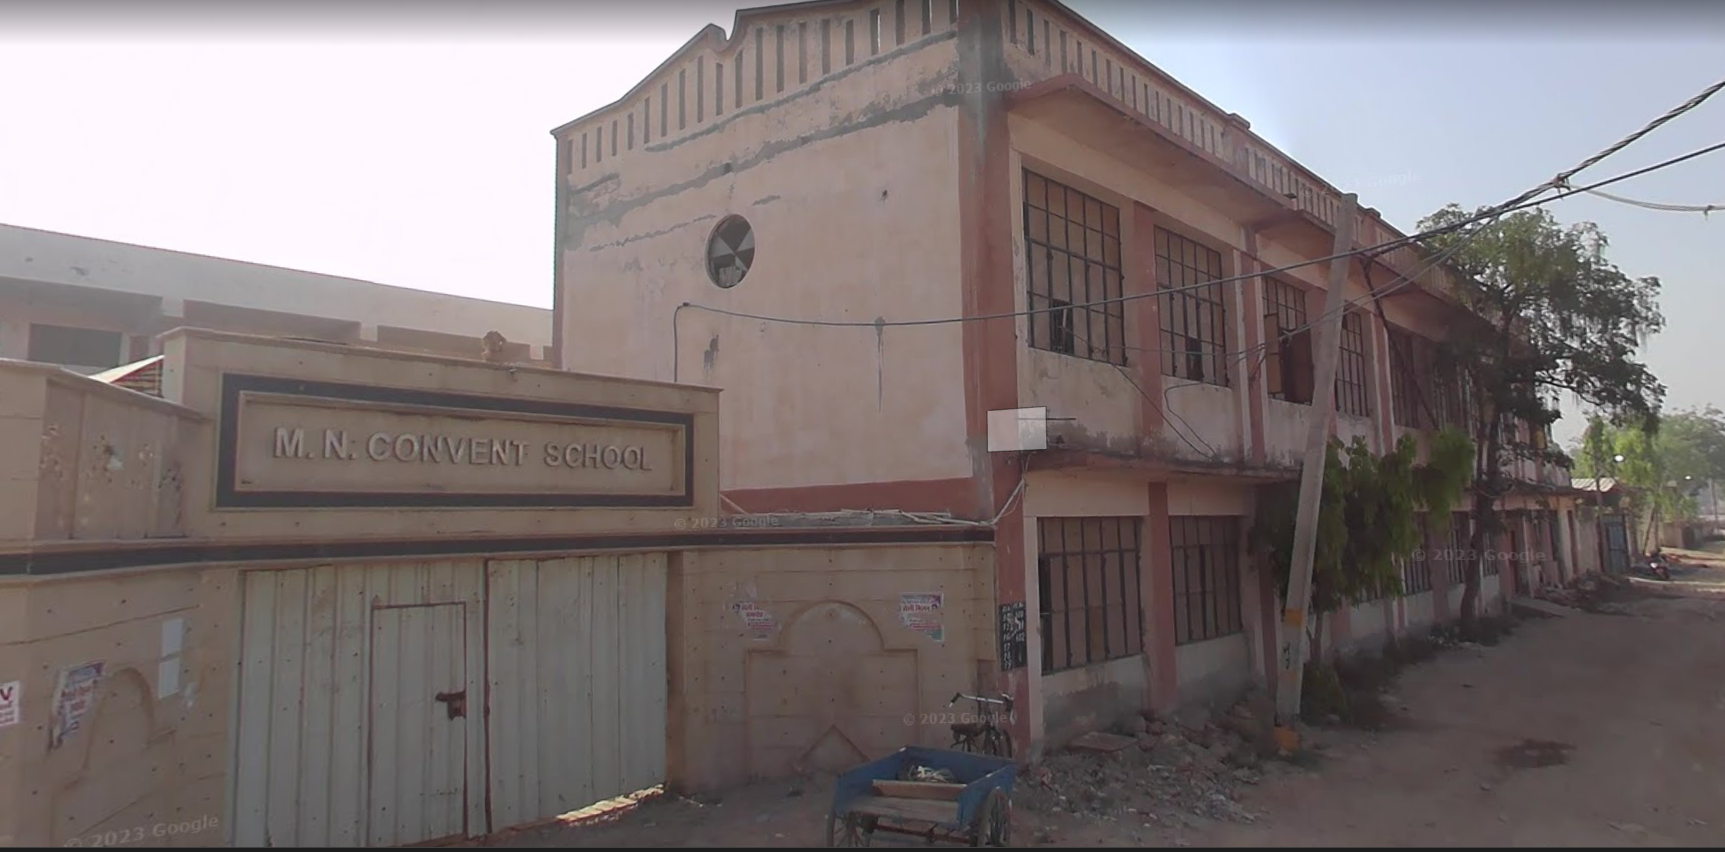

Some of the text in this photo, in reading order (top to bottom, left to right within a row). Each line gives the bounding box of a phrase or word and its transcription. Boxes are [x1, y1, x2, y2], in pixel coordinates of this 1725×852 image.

[272, 426, 314, 460] M.
[365, 431, 529, 466] CONVENT
[542, 441, 653, 472] SCHOOL
